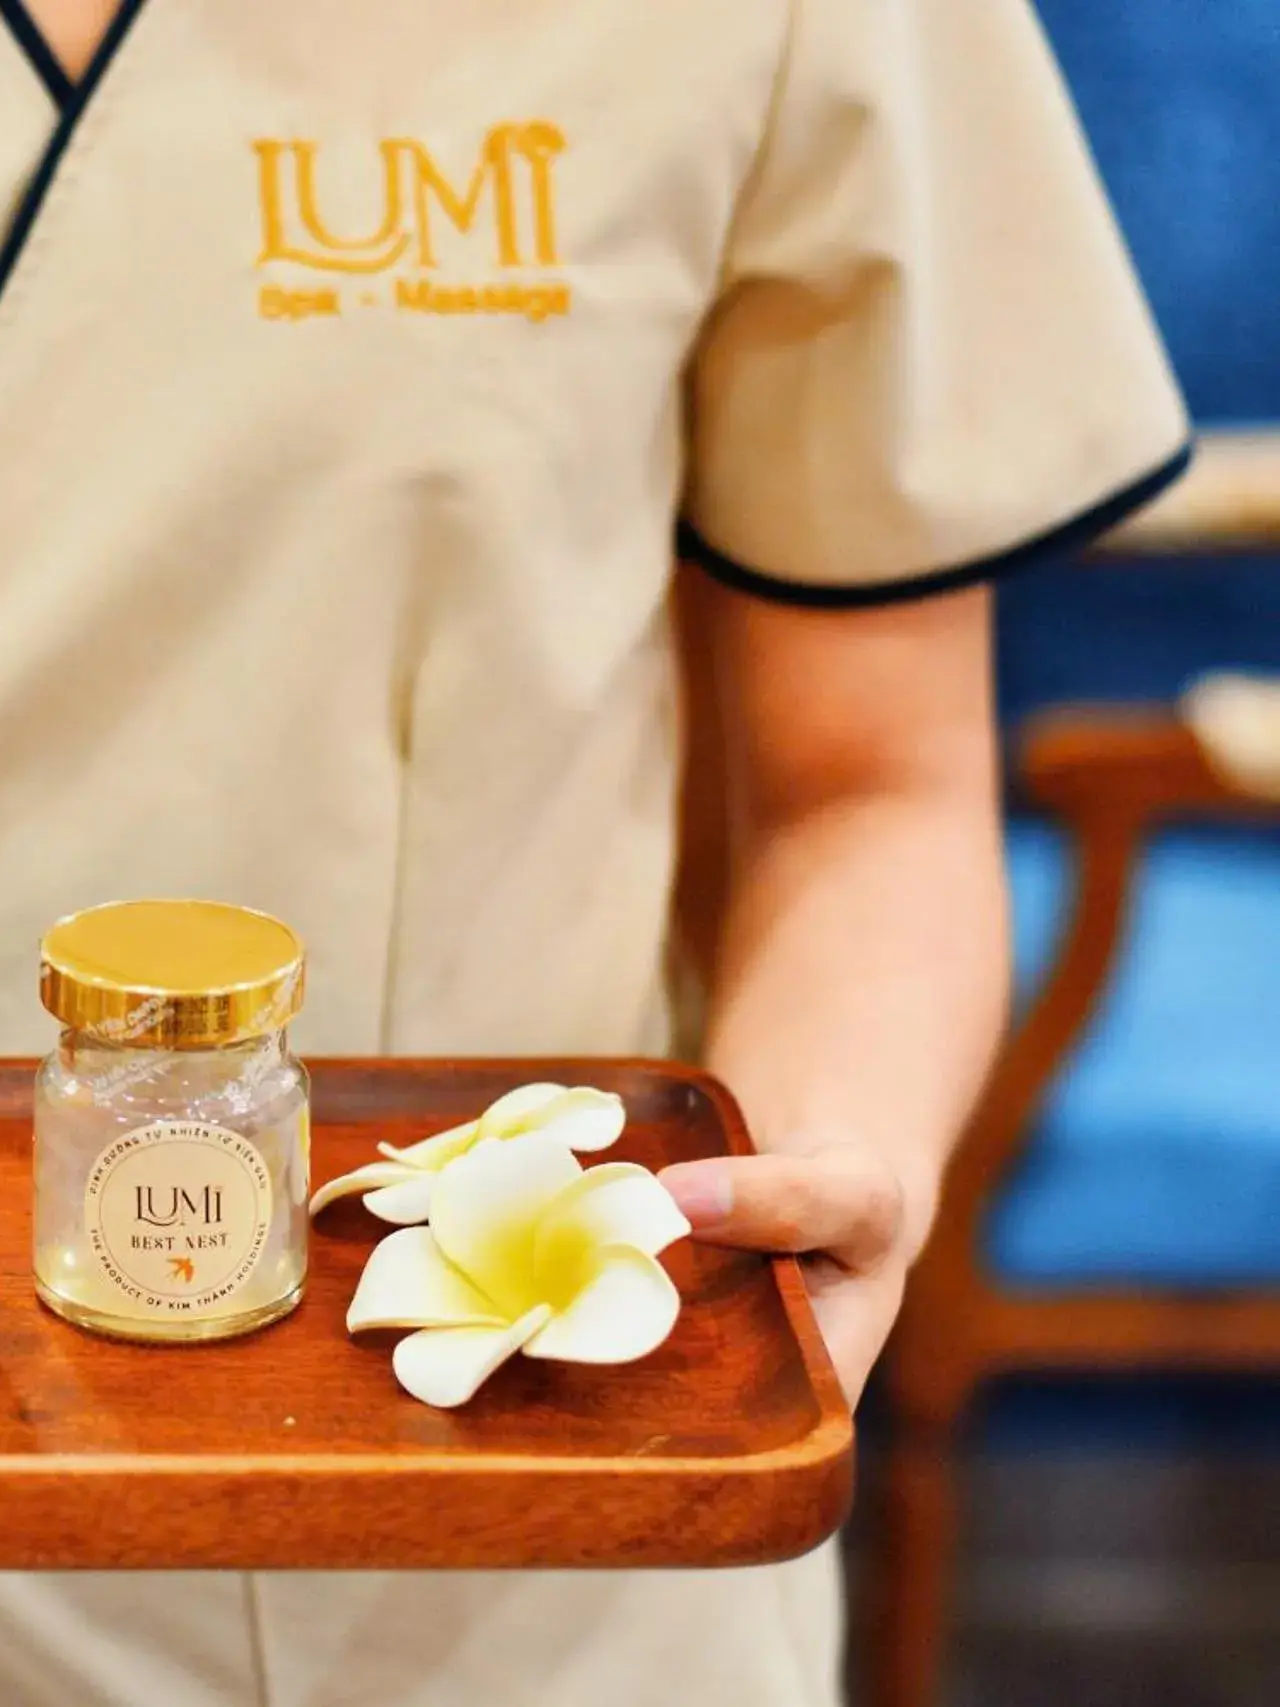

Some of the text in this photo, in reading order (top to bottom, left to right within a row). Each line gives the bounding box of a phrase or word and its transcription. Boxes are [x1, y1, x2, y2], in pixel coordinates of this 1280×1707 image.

[252, 120, 566, 273] LUMI
[134, 1183, 224, 1227] LUMI
[131, 1232, 230, 1251] BEST NEST
[101, 1255, 141, 1298] PRODUCT
[146, 1296, 161, 1306] OF
